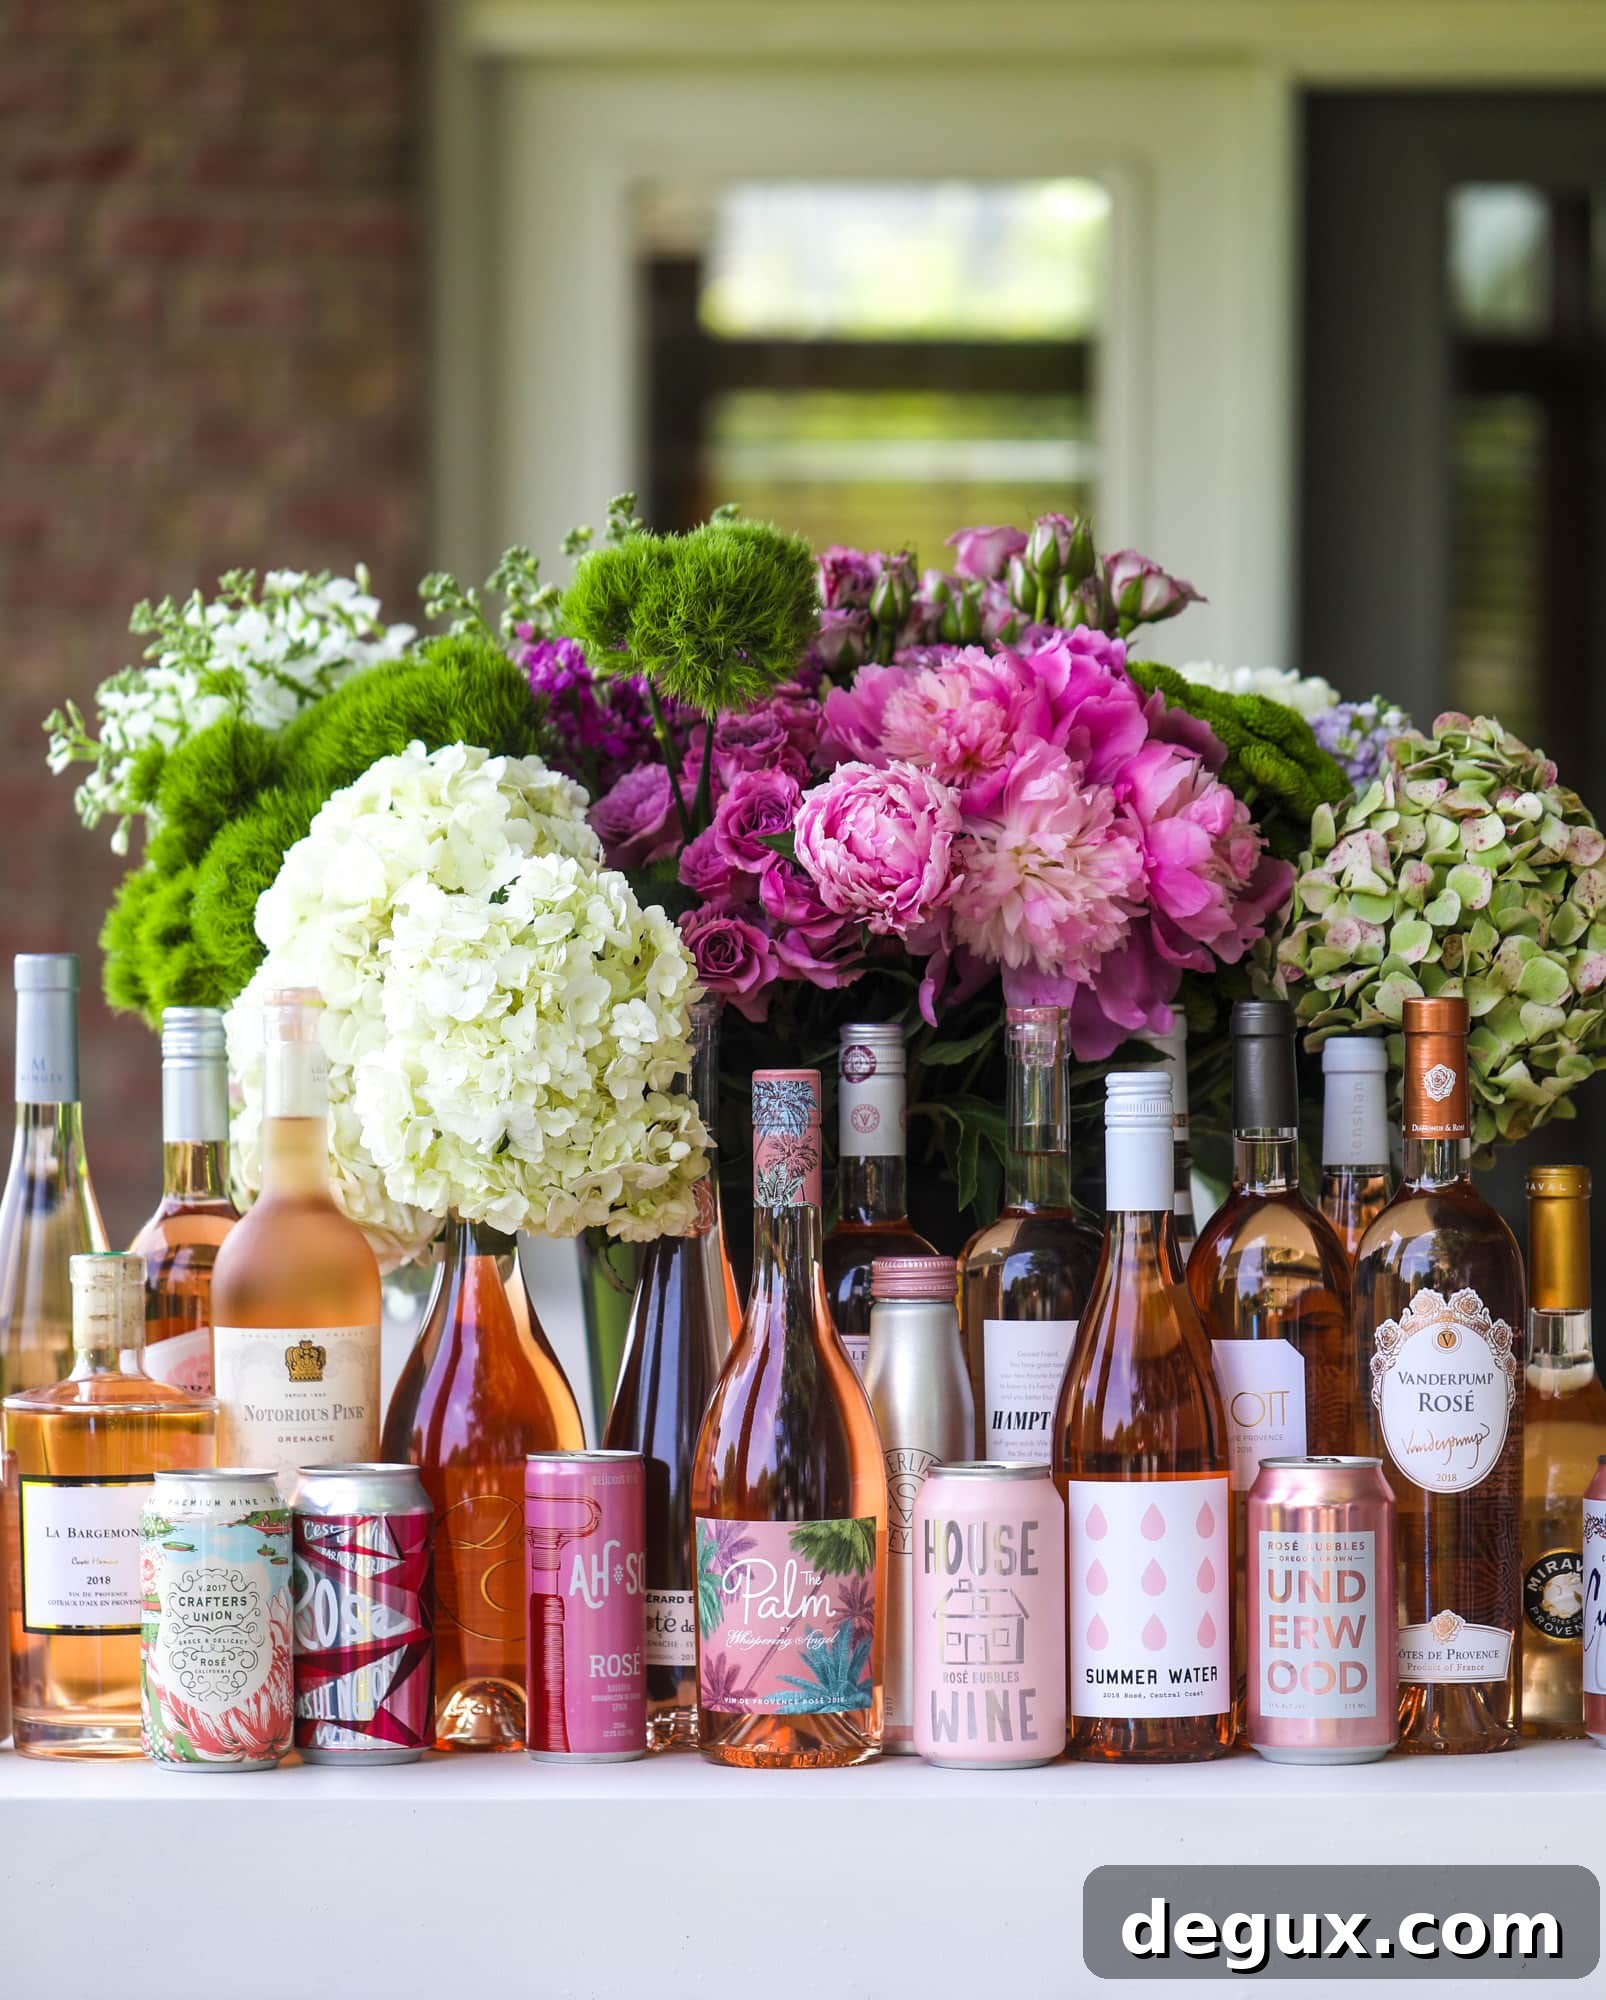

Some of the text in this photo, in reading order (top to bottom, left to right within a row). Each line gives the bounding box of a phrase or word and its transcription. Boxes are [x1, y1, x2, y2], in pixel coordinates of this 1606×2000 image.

[1397, 1370, 1494, 1386] VANDERPUMP
[1418, 1389, 1475, 1413] ROSÉ
[243, 1403, 365, 1423] NOTORIOUS PINK
[992, 1410, 1052, 1431] HAMPT
[1436, 1472, 1457, 1483] 2018
[67, 1526, 147, 1539] BARGEMON
[924, 1519, 1039, 1577] HOUSE
[1267, 1539, 1300, 1552] ROSÉ
[86, 1575, 112, 1586] 2018
[799, 1570, 823, 1586] The
[722, 1558, 836, 1624] Palm
[1267, 1570, 1367, 1604] UND
[178, 1596, 248, 1608] CRAFTERS
[646, 1593, 686, 1604] ÉRARD
[193, 1611, 233, 1622] UNION
[1529, 1605, 1584, 1636] PROVEN
[1268, 1615, 1367, 1649] ERW
[200, 1656, 227, 1667] ROSÉ
[588, 1645, 642, 1679] ROSÉ
[1398, 1648, 1500, 1660] ÔTES DE PROVENCE
[1456, 1662, 1485, 1672] France
[942, 1670, 968, 1684] ROSÉ
[1086, 1666, 1218, 1685] SUMMER WATER
[1267, 1660, 1368, 1696] OOD
[739, 1697, 749, 1705] DE
[752, 1697, 798, 1705] PROVENCE
[931, 1688, 1039, 1743] WINE
